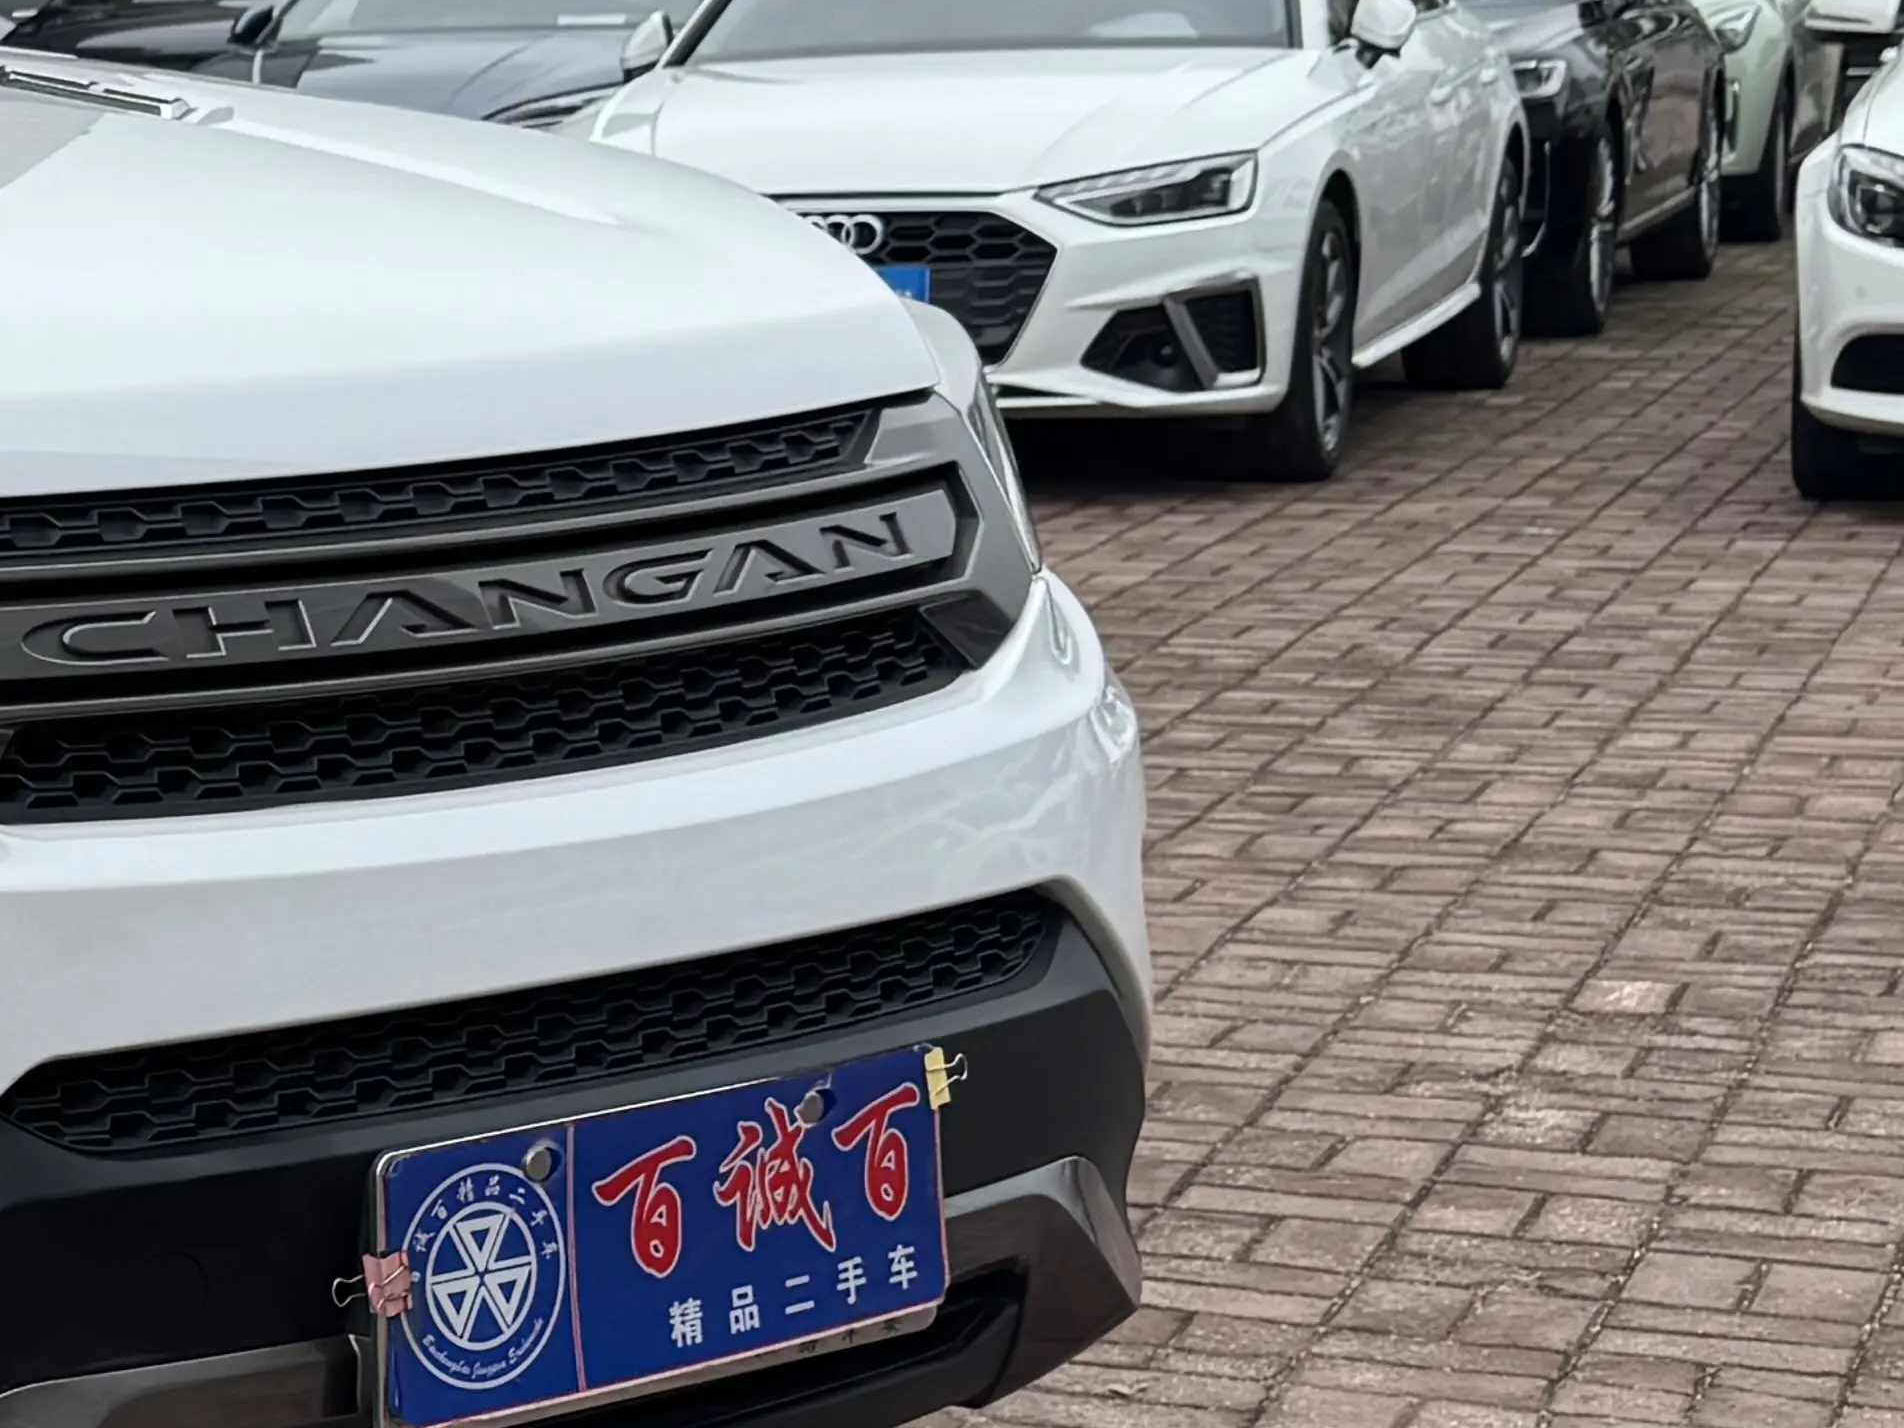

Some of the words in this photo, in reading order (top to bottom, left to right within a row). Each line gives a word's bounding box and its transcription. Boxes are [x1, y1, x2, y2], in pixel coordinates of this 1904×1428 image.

[19, 513, 912, 668] CHANGAN
[668, 1243, 919, 1349] 精品二手车
